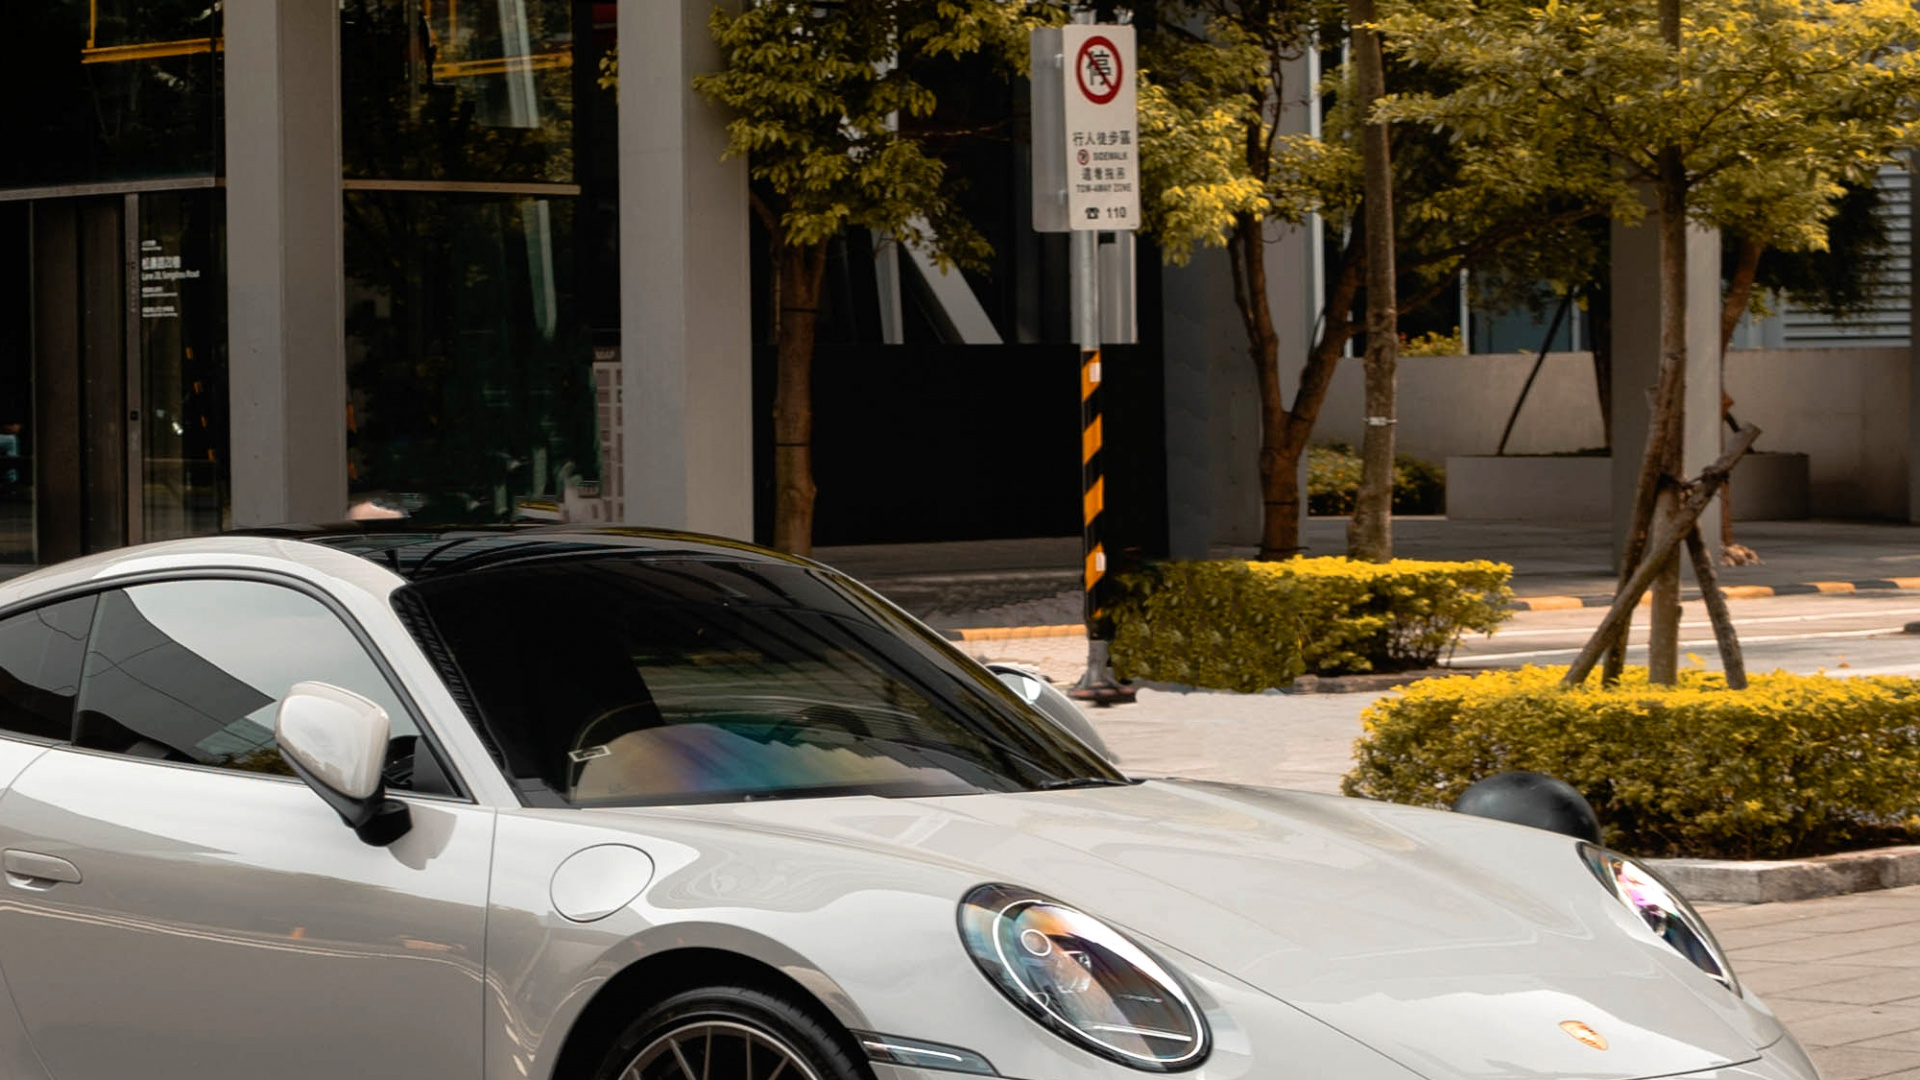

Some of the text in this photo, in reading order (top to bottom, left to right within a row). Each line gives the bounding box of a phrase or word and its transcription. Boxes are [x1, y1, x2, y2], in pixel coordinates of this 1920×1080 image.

[1086, 50, 1112, 86] 停
[1072, 130, 1131, 146] 行人徒步區
[1093, 151, 1128, 161] SIDEWALK
[1076, 182, 1132, 193] TOW-AWAY ZONE
[1106, 206, 1127, 219] 110
